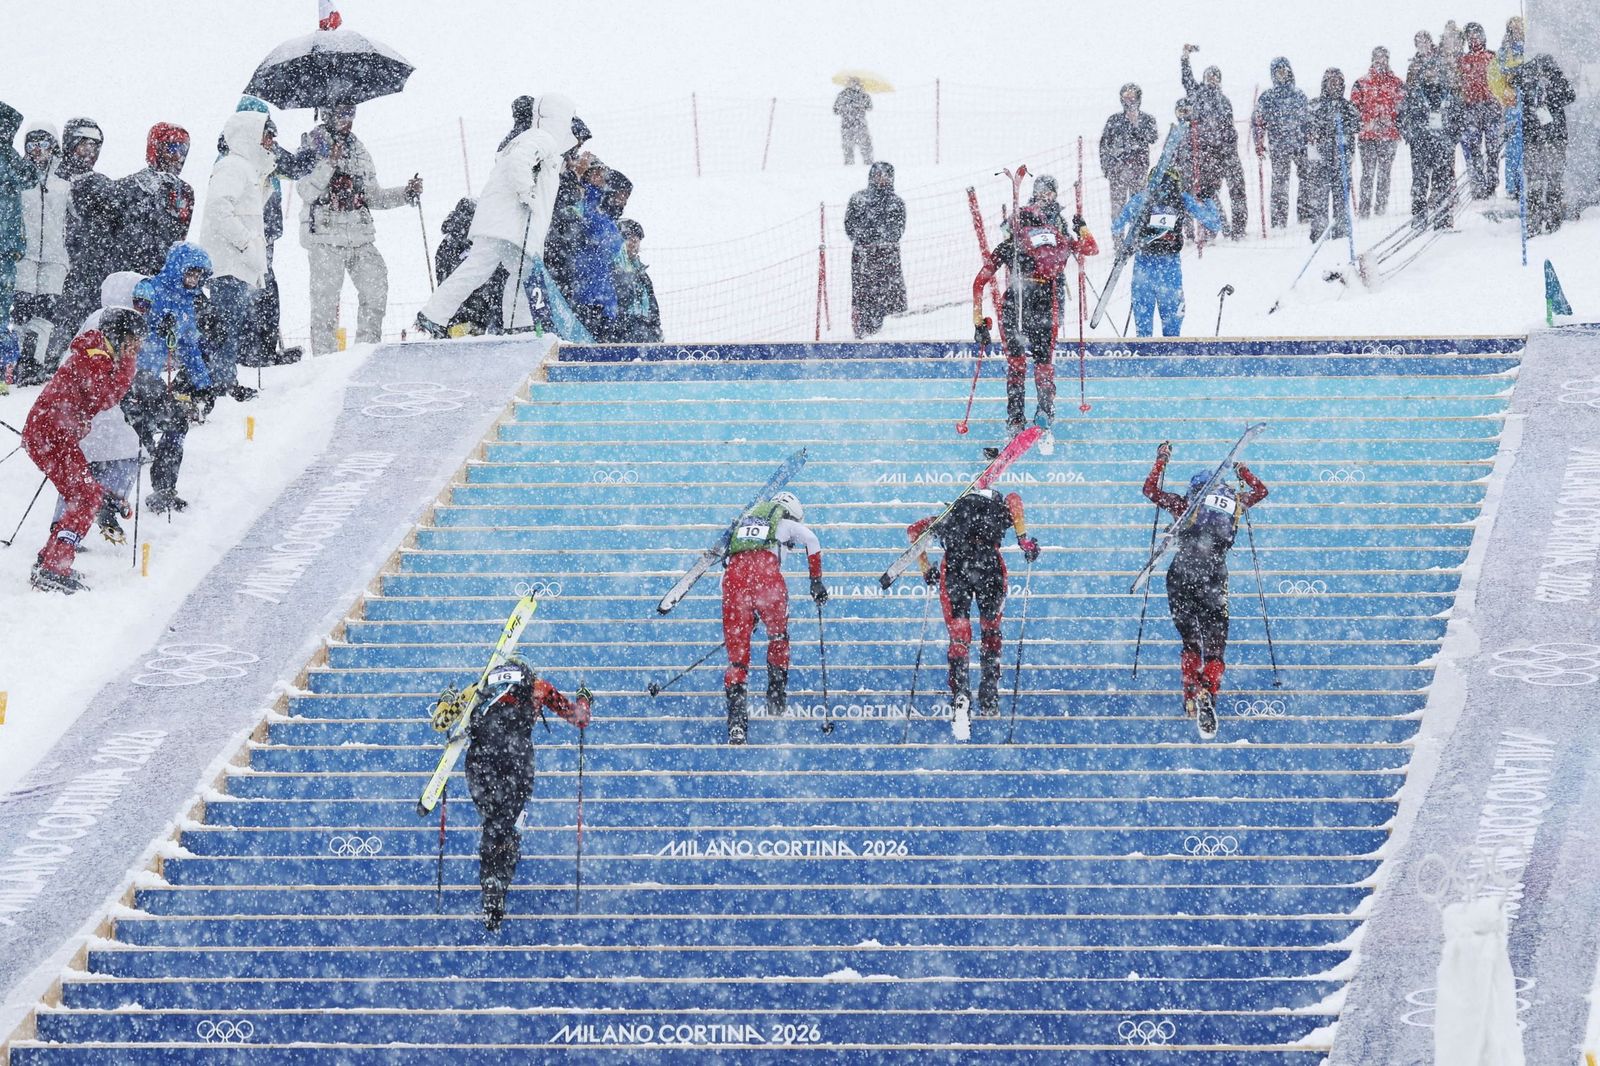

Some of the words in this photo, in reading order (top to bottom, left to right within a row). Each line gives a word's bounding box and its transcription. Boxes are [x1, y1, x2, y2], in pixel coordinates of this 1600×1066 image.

[531, 287, 546, 310] 2
[876, 472, 953, 483] MILANO
[1046, 472, 1085, 483] 2026
[1214, 496, 1228, 509] 15
[745, 527, 760, 537] 10
[497, 672, 512, 681] 16
[831, 704, 925, 718] CORTINA
[1486, 730, 1558, 802] MILANO
[655, 840, 752, 857] MILANO
[758, 840, 857, 857] CORTINA
[862, 840, 909, 857] 2026
[549, 1024, 654, 1042] MILANO
[658, 1024, 766, 1042] CORTINA
[771, 1024, 821, 1043] 2026
